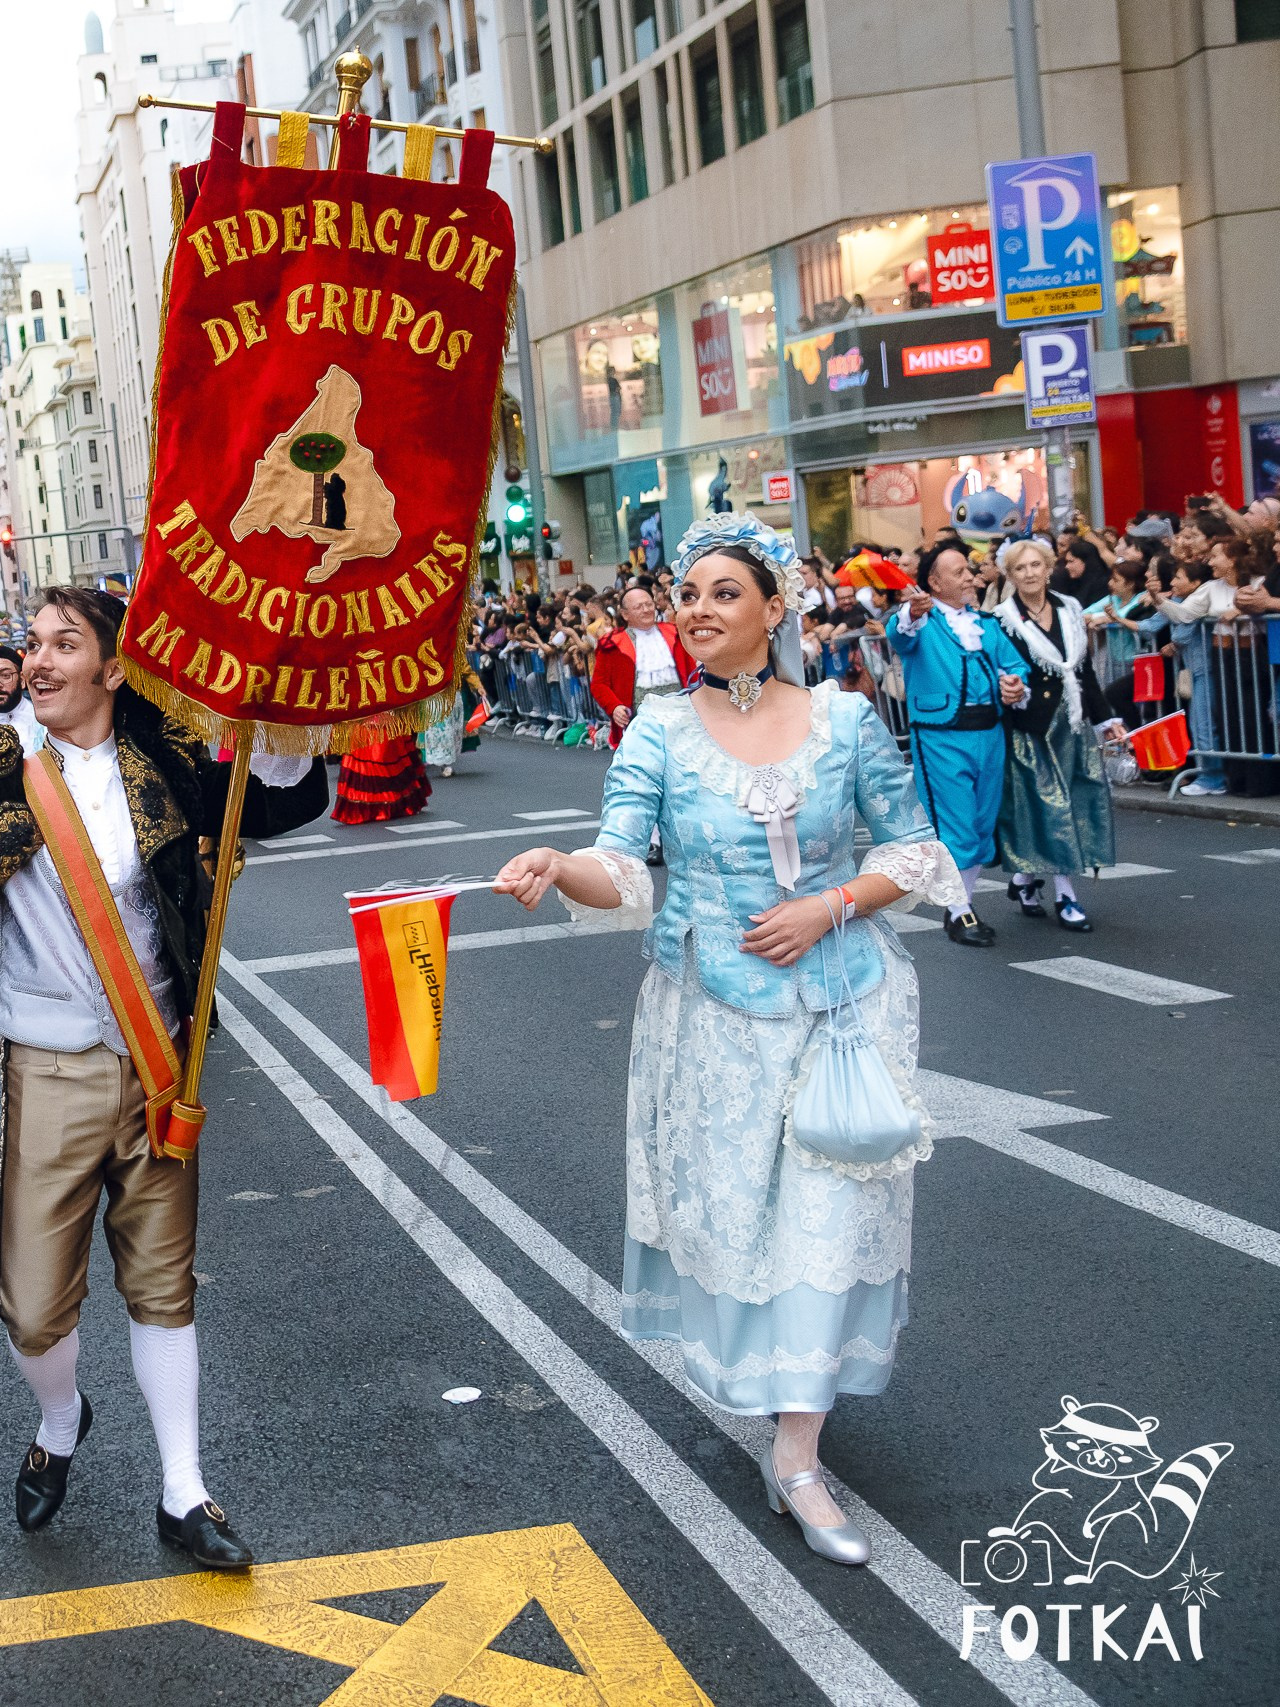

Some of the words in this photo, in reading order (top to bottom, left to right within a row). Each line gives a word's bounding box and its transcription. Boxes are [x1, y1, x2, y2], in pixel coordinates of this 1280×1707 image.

[187, 199, 504, 292] FEDERACIÓN
[934, 243, 988, 268] MINI
[1012, 176, 1081, 272] P
[1063, 269, 1081, 284] 24
[1085, 268, 1096, 281] H
[201, 300, 268, 366] DE
[285, 282, 473, 371] GRUPOS
[697, 336, 730, 365] MINI
[908, 345, 983, 371] MINISO
[1026, 334, 1077, 398] P
[155, 499, 468, 639] TRADICIONALES
[135, 609, 445, 710] MADRILEÑOS
